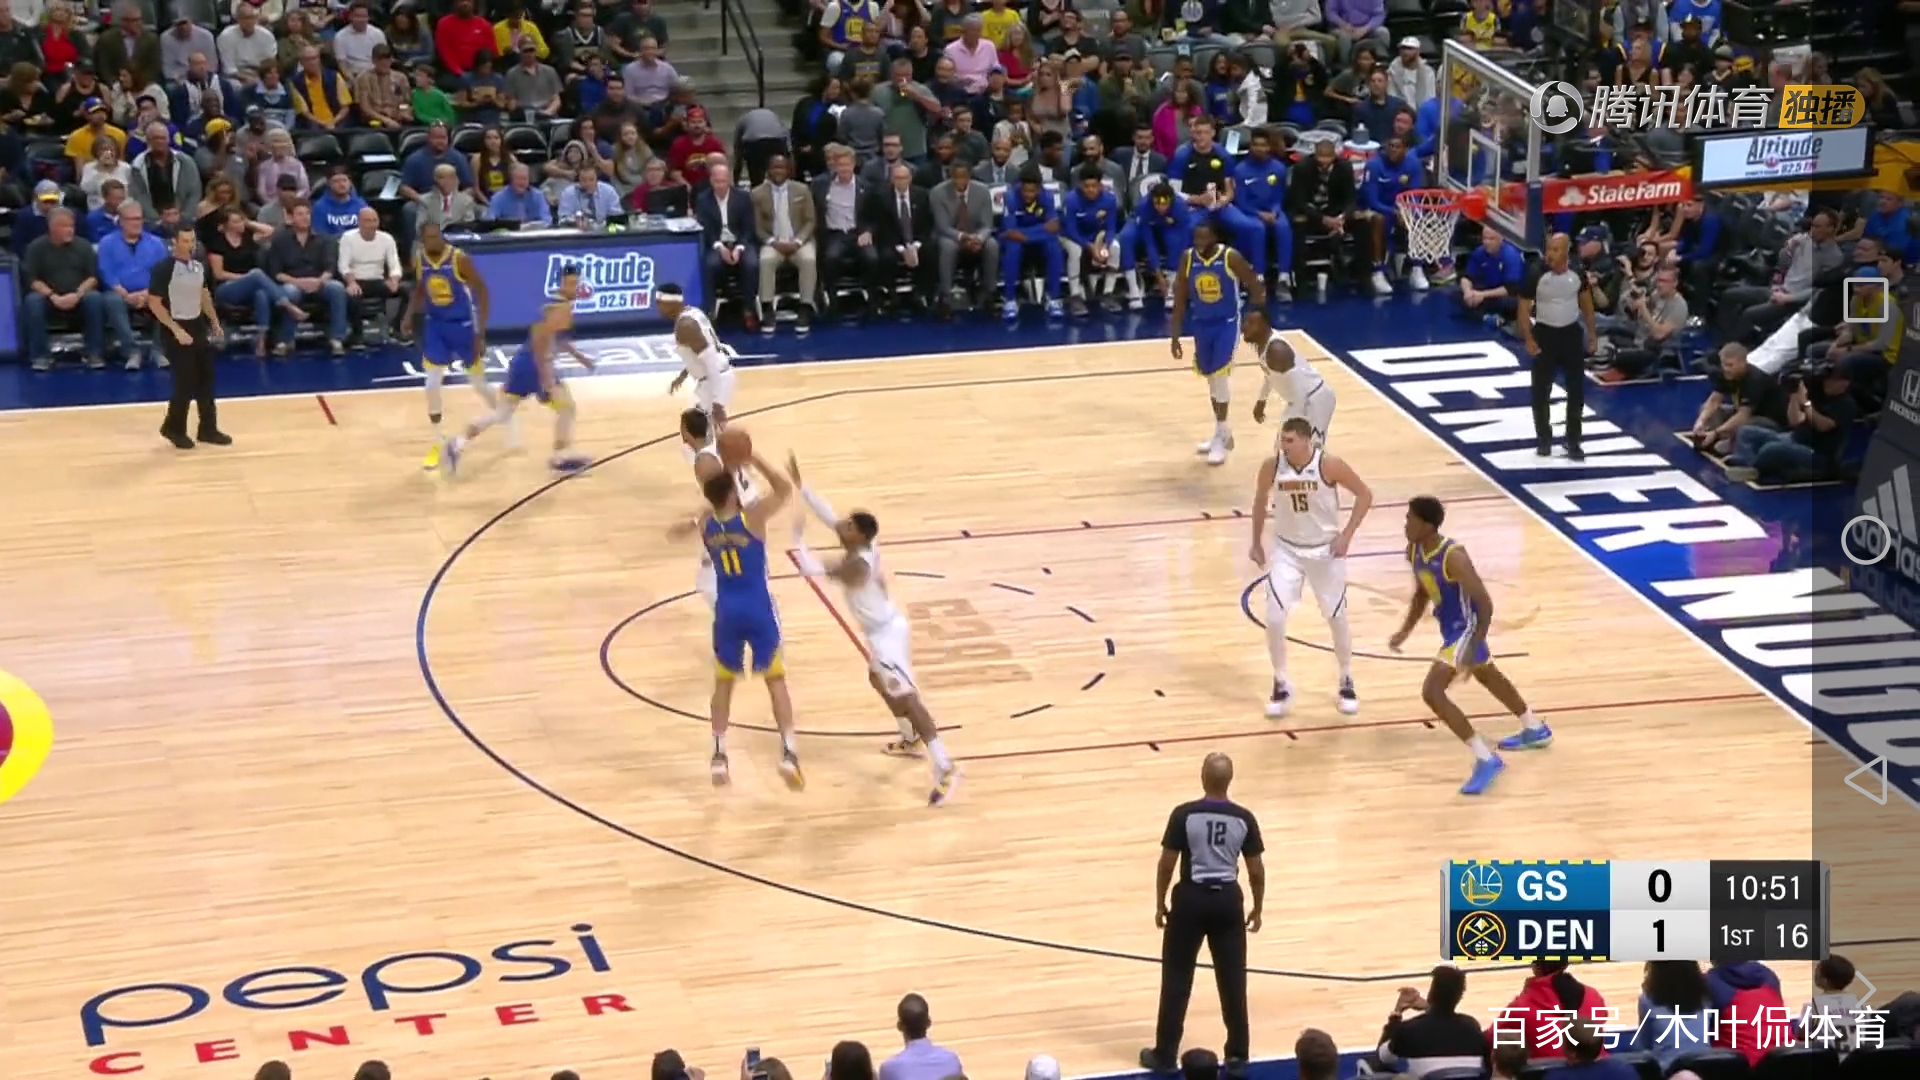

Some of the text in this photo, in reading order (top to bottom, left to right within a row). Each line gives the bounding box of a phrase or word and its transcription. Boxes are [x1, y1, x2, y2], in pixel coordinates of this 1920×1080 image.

[1747, 135, 1823, 163] Altitude
[548, 254, 651, 294] Atitude
[600, 294, 627, 308] 92.5
[630, 291, 648, 306] FM
[1346, 340, 1769, 552] DENVER
[1278, 480, 1318, 491] NETS
[1291, 493, 1309, 512] 15
[721, 549, 741, 576] 11
[1206, 821, 1227, 845] 12
[80, 923, 611, 1047] pepsi
[88, 993, 636, 1075] CENTER
